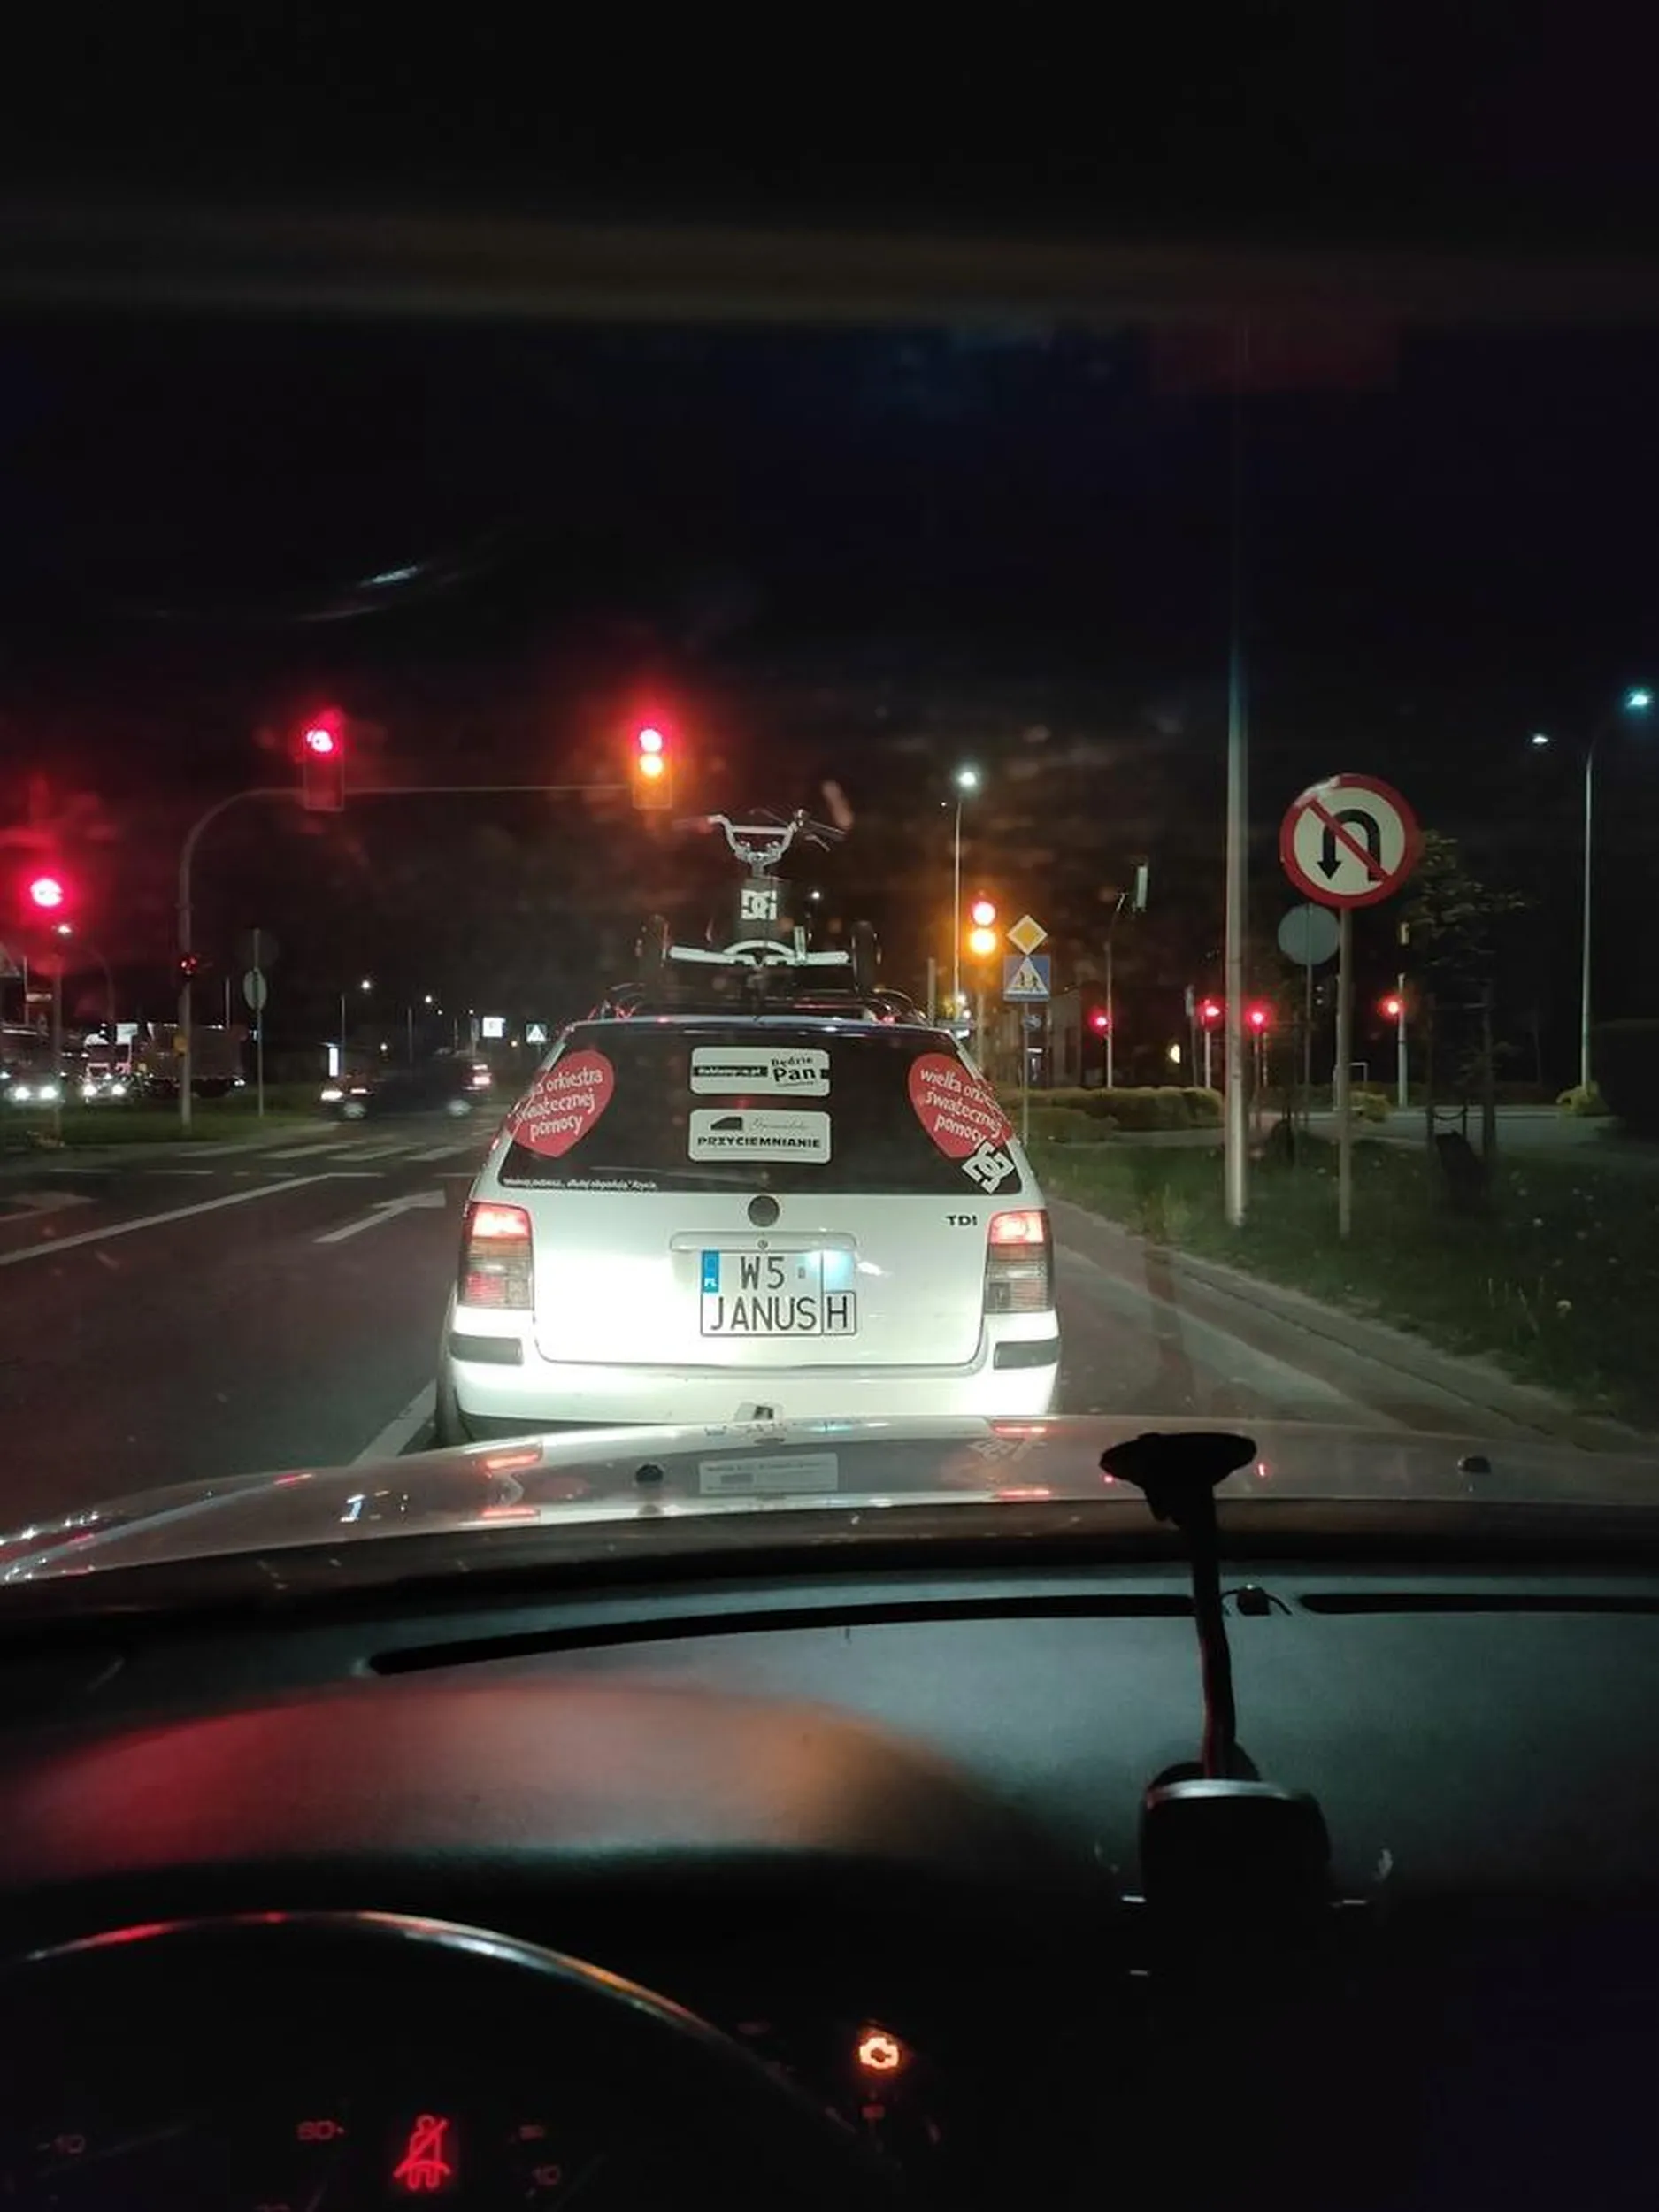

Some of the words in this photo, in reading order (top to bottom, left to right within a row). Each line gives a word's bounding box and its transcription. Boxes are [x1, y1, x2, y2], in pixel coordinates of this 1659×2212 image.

[546, 1067, 603, 1092] orkiestra
[772, 1067, 816, 1082] Pan
[920, 1069, 962, 1093] wielka
[529, 1115, 582, 1142] pomocy
[934, 1114, 987, 1148] pomocy
[697, 1136, 821, 1148] PRZYCIEMNIANIE
[945, 1215, 977, 1226] TDI
[741, 1256, 785, 1290] W5
